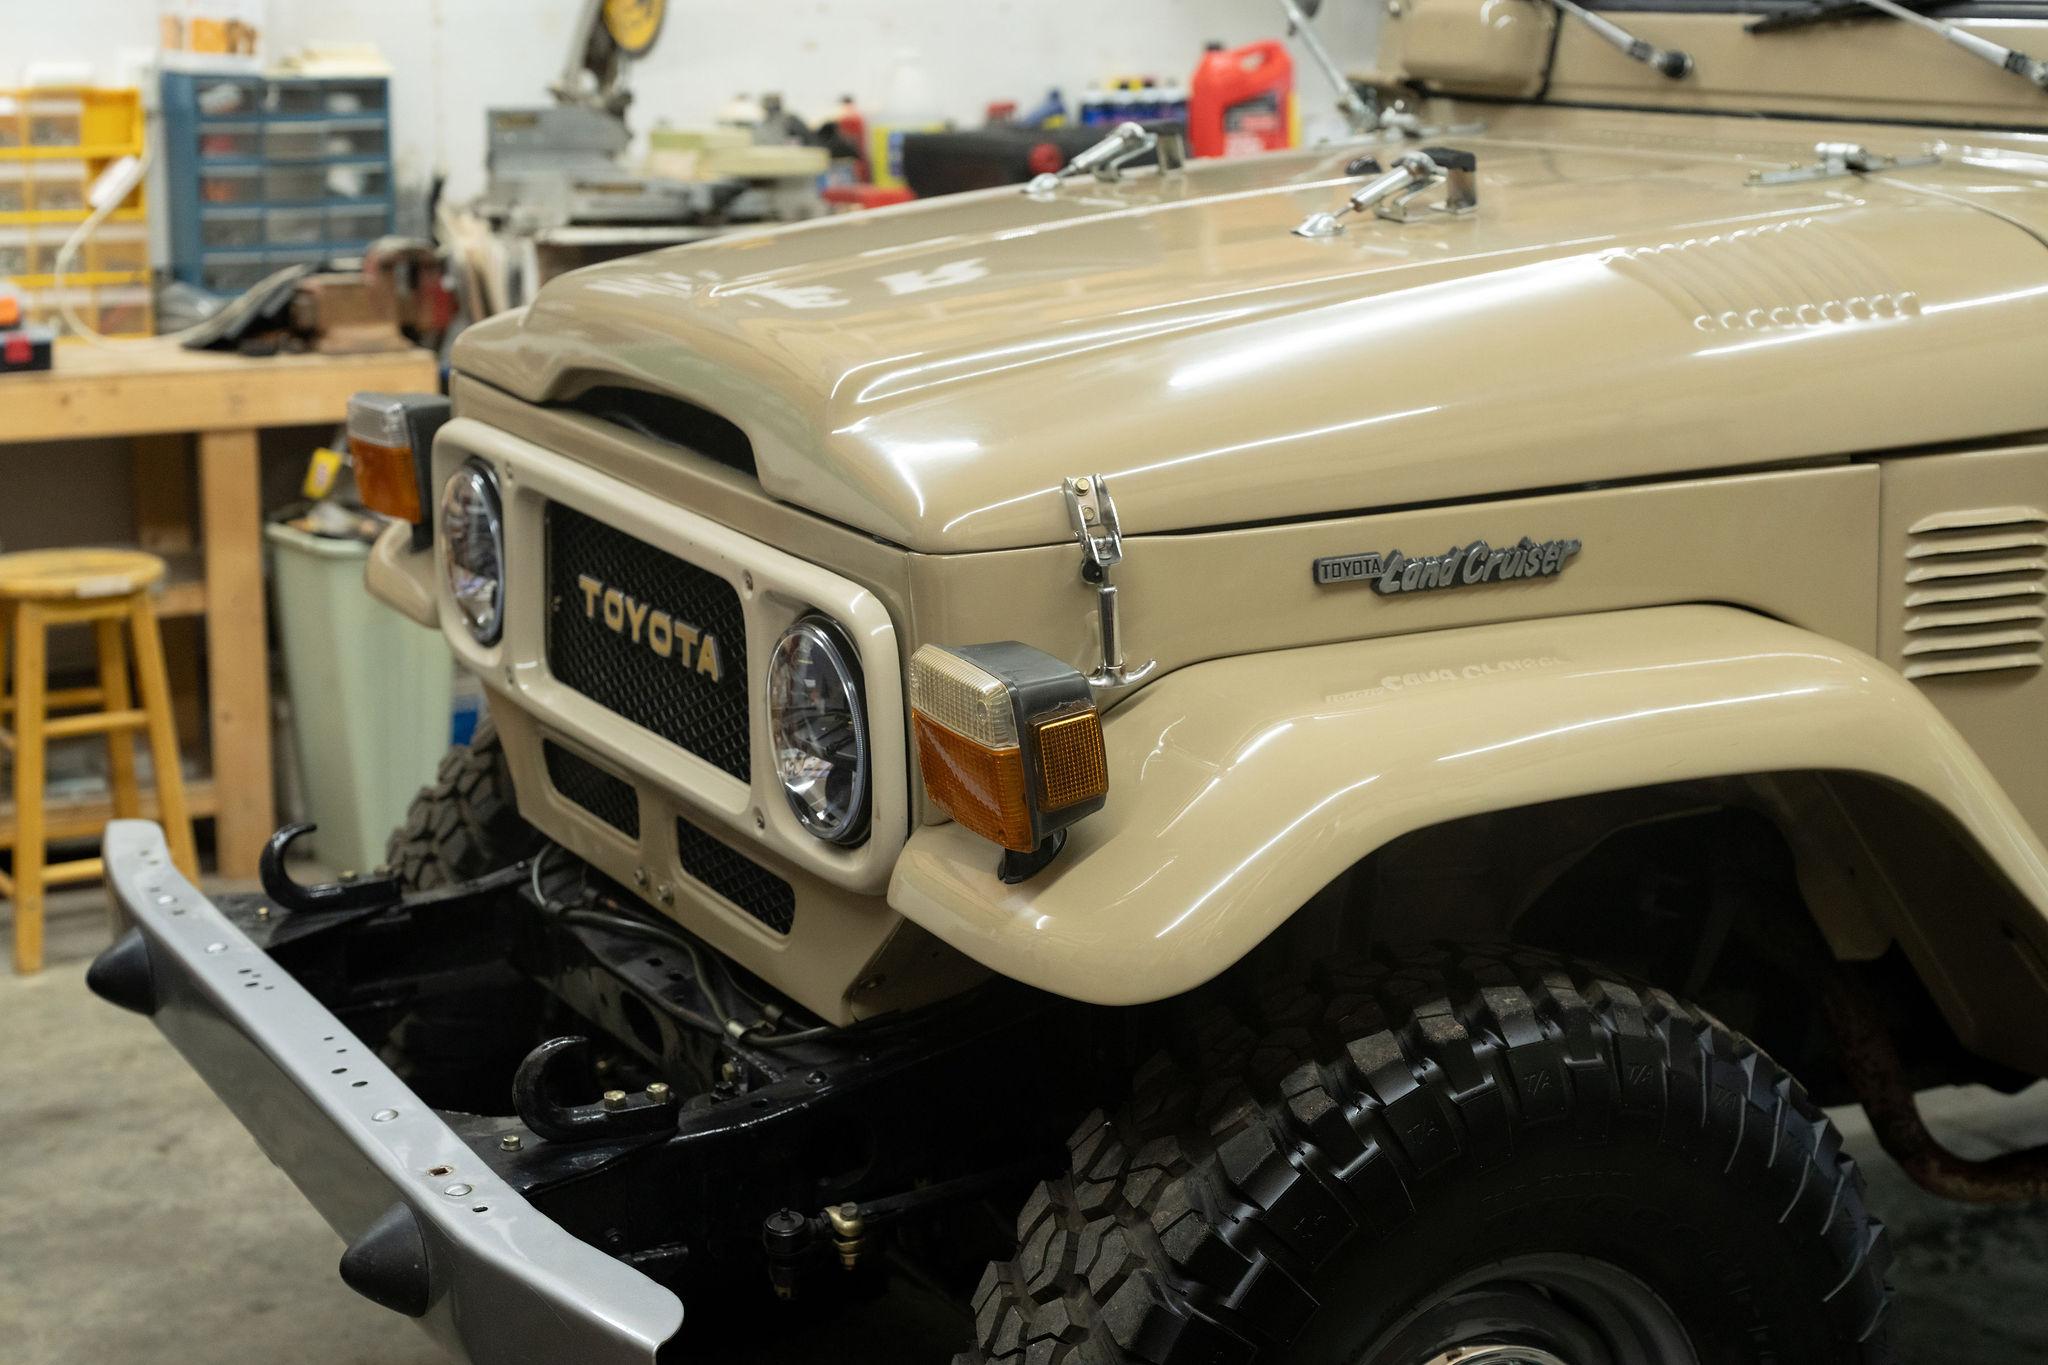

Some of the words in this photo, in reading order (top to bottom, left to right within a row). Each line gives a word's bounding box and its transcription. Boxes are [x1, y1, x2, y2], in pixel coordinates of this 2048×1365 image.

[1320, 557, 1381, 579] TOYOTA
[1374, 549, 1461, 594] Land
[1461, 536, 1581, 585] Cruiser
[578, 573, 723, 683] TOYOTA
